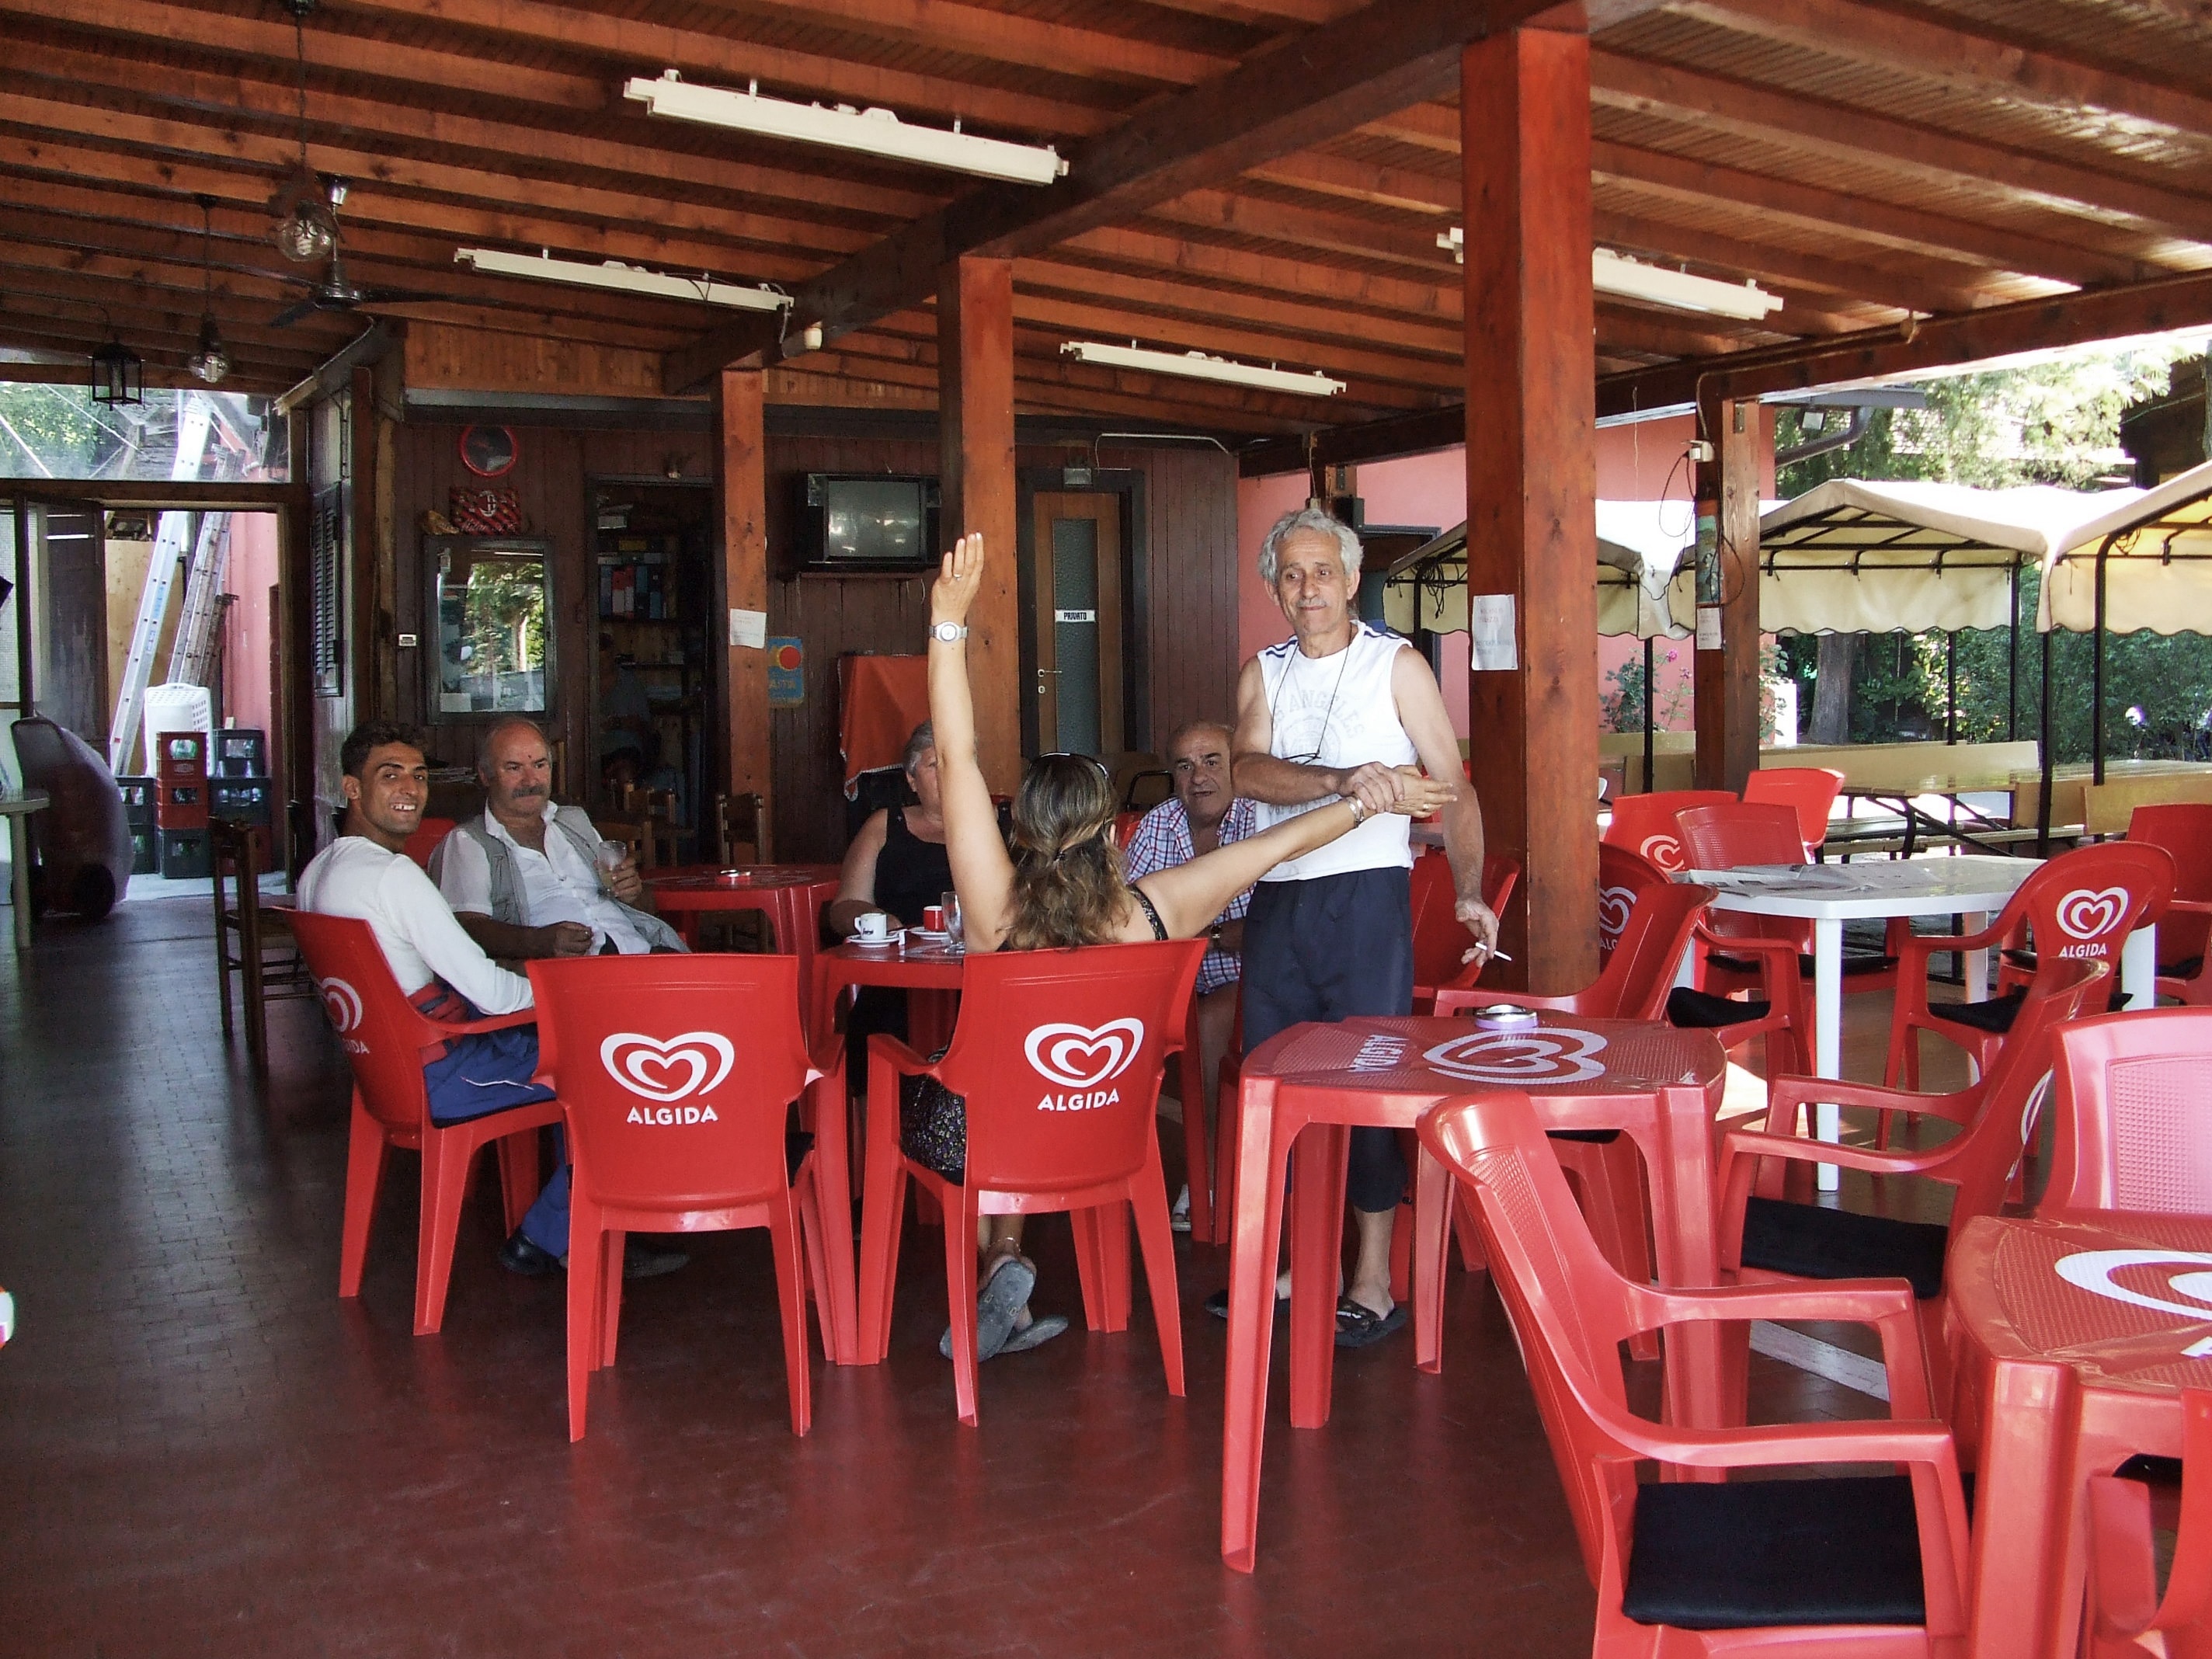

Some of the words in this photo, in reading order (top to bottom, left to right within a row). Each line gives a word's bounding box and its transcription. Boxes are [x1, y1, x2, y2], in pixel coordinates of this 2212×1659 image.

[1063, 611, 1087, 621] PRIVATO
[2057, 942, 2107, 958] ALGIDA
[1347, 1034, 1410, 1073] ALGIDA
[1037, 1087, 1120, 1111] ALGIDA
[626, 1104, 718, 1125] ALGIDA
